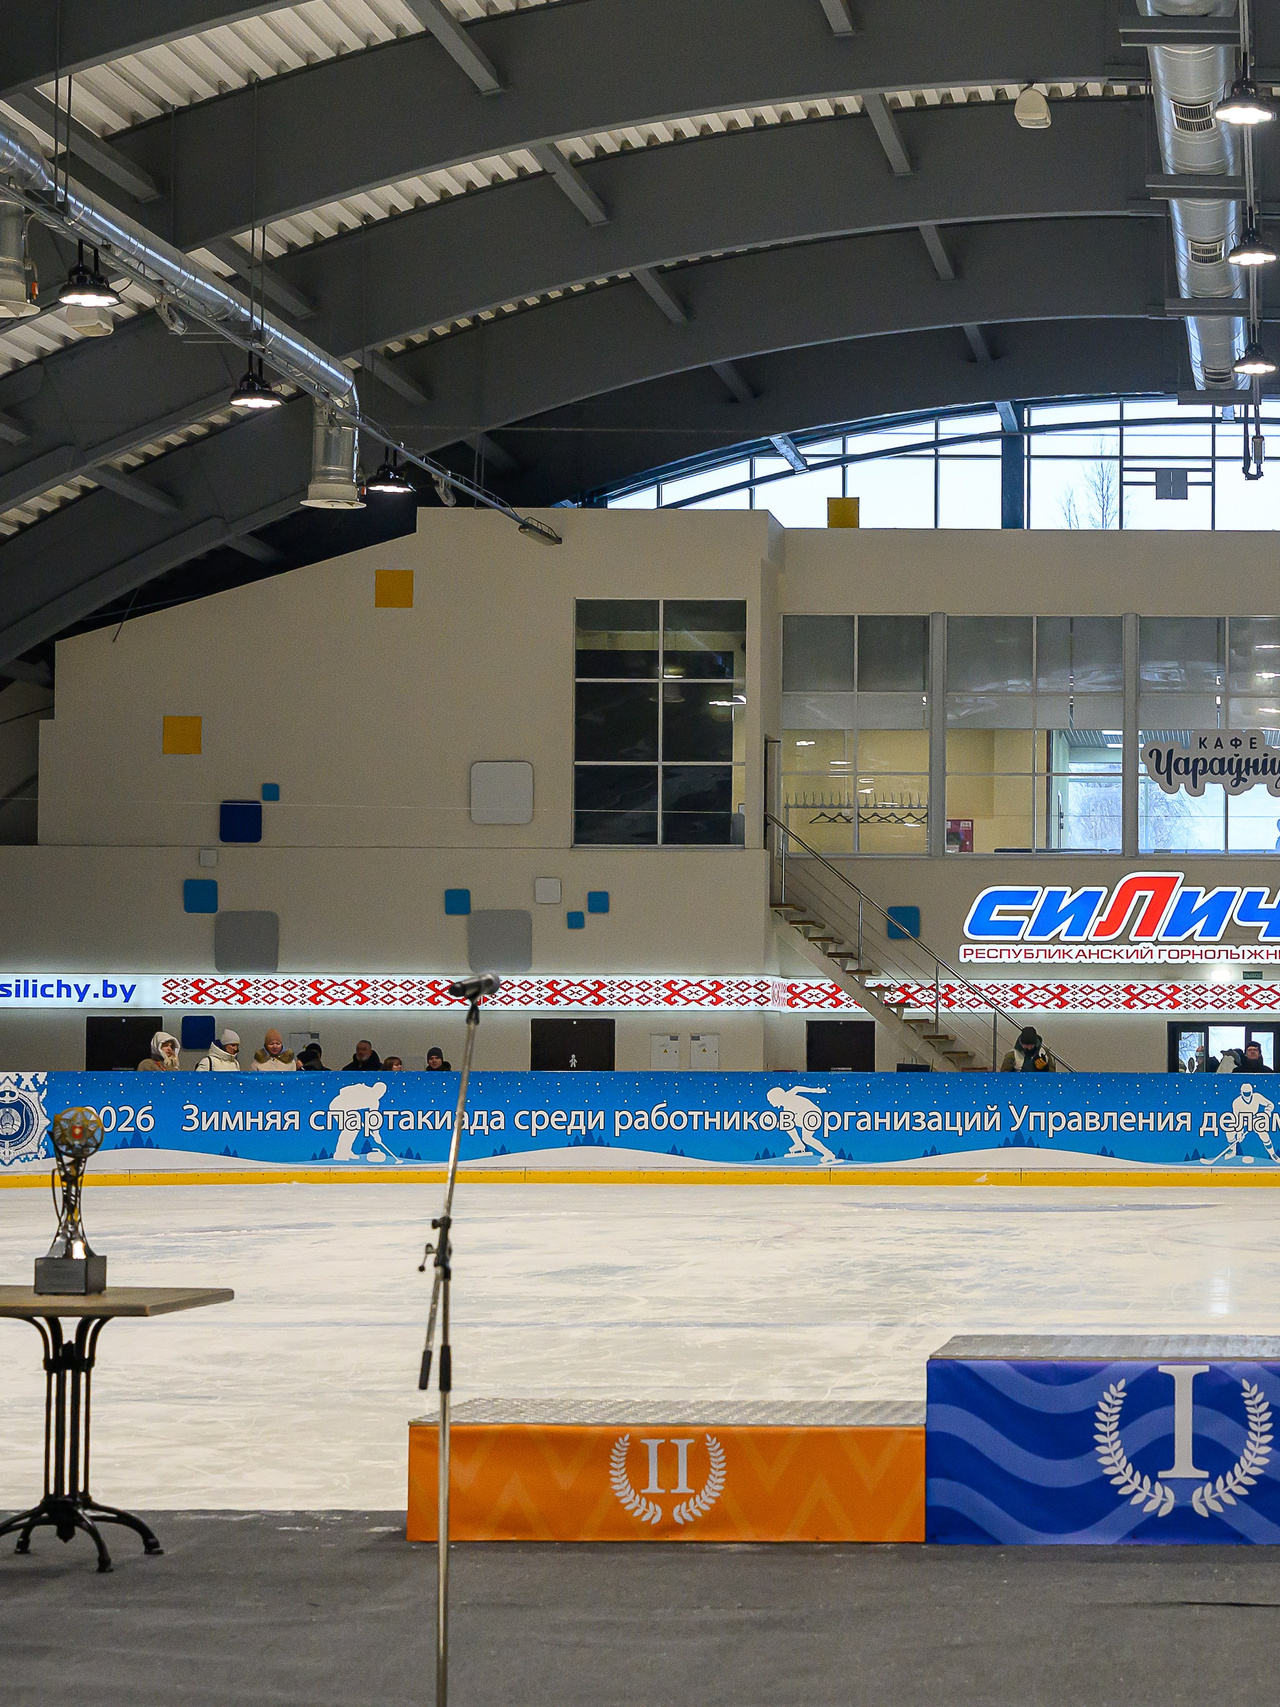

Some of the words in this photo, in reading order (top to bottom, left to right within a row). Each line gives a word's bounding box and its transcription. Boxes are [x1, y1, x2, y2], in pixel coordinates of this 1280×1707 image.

[1198, 736, 1258, 750] КАФЕ
[962, 945, 1153, 960] РЕСПУБЛИКАНСКИЙ
[0, 979, 137, 1003] silichy.by
[181, 1103, 300, 1132] Зимняя
[309, 1109, 505, 1138] спартакиада
[513, 1109, 605, 1137] среди
[613, 1102, 797, 1137] работников
[802, 1104, 1002, 1138] организаций
[1008, 1104, 1192, 1139] Управления
